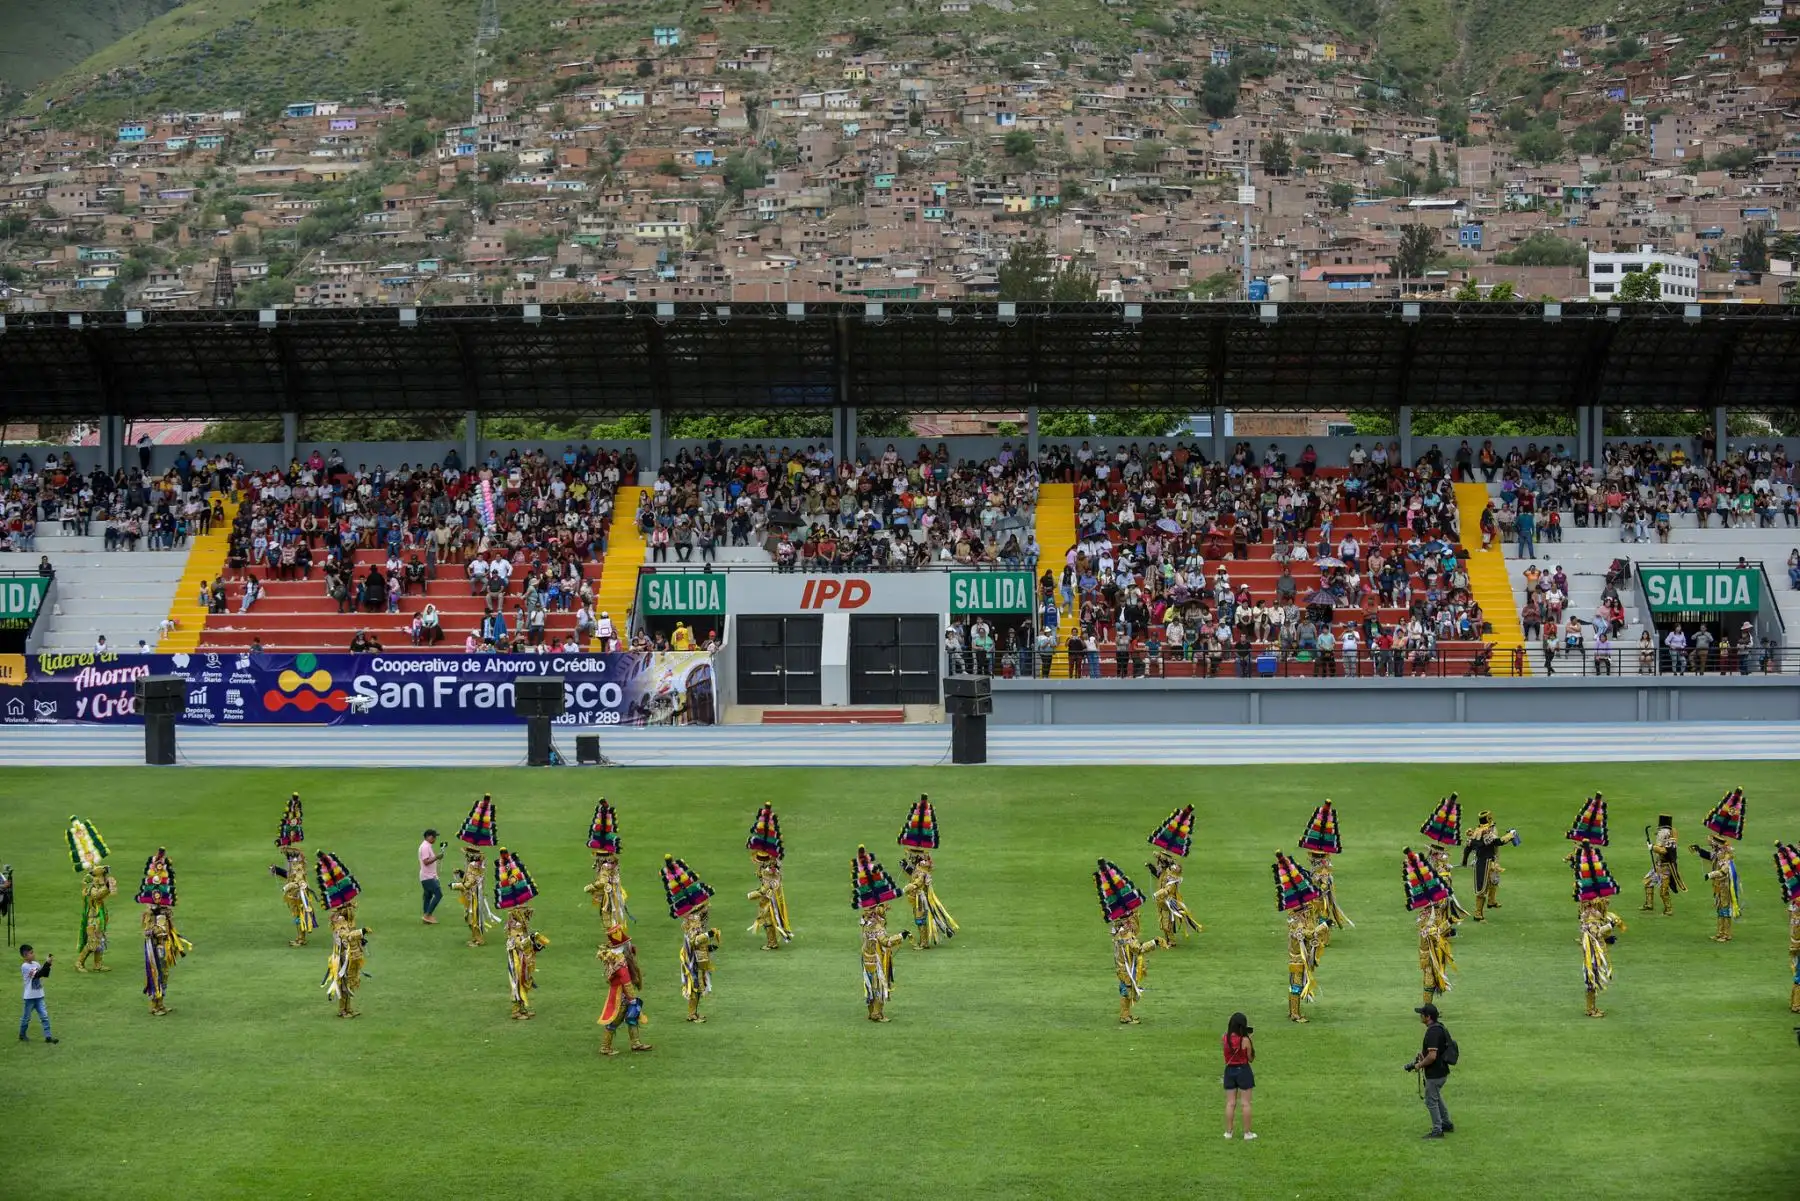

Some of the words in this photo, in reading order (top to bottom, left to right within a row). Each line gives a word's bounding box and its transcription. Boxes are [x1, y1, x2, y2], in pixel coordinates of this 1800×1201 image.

[648, 579, 720, 611] SALIDA
[800, 579, 871, 609] IPD
[955, 577, 1028, 609] SALIDA
[1648, 575, 1750, 605] SALIDA
[73, 664, 150, 692] Ahorros
[371, 657, 459, 675] Cooperativa
[462, 657, 481, 672] de
[484, 657, 536, 673] Ahorro
[540, 660, 549, 675] y
[552, 657, 606, 672] Crédito
[353, 675, 425, 709] San
[434, 676, 623, 709] Fransco
[76, 697, 88, 718] y
[595, 711, 620, 724] 289
